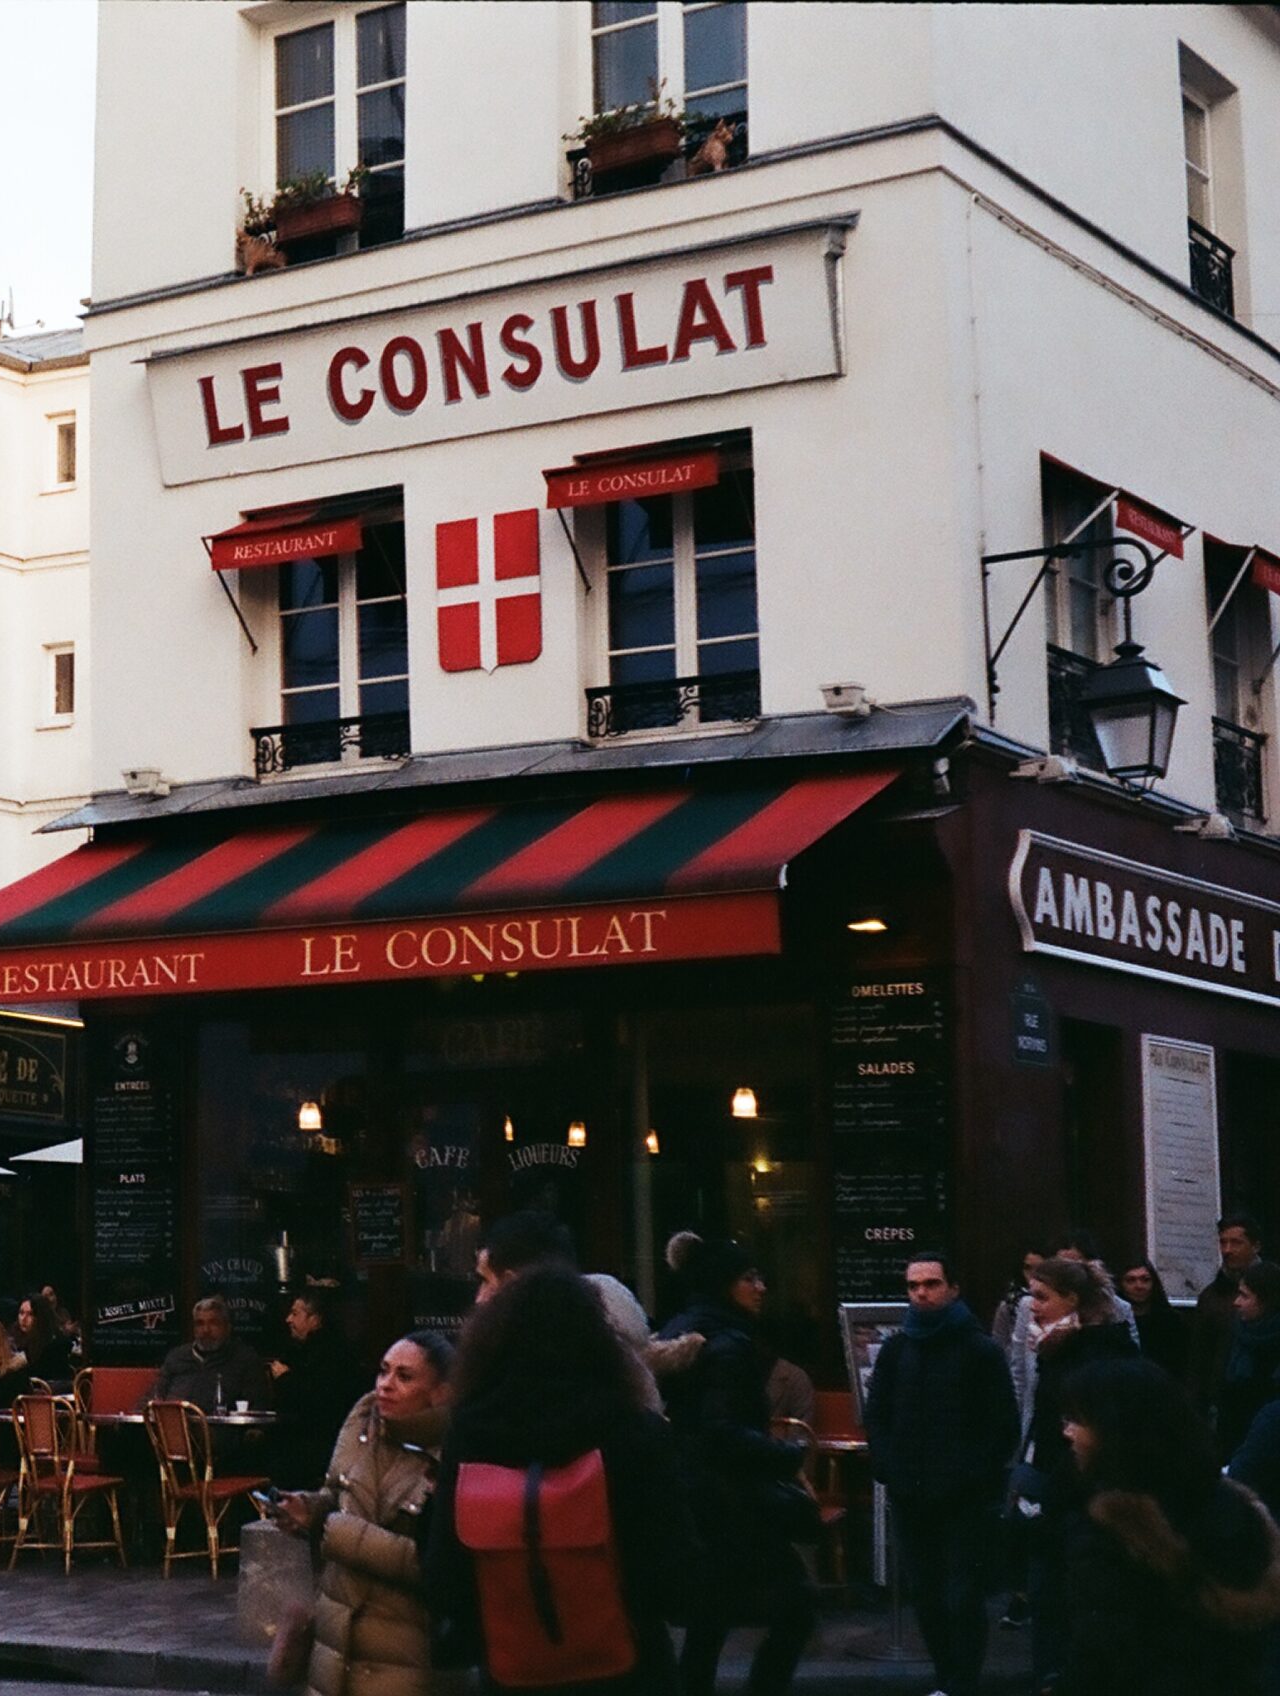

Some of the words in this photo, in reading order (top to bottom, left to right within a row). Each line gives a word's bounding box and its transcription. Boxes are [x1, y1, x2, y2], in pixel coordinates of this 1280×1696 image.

[198, 361, 292, 449] LE
[326, 264, 774, 425] CONSULAT
[568, 479, 590, 499] LE
[597, 464, 696, 494] CONSULAT
[232, 530, 337, 562] RESTAURANT
[1033, 866, 1246, 974] AMBASSADE
[299, 933, 362, 977] LE
[385, 909, 668, 970] CONSULAT
[851, 982, 925, 998] OMELETTES
[16, 1057, 39, 1083] DE
[857, 1061, 916, 1076] SALADES
[507, 1142, 582, 1172] LIQUEURS
[119, 1173, 146, 1184] PLATS
[864, 1227, 915, 1241] CRÊPES
